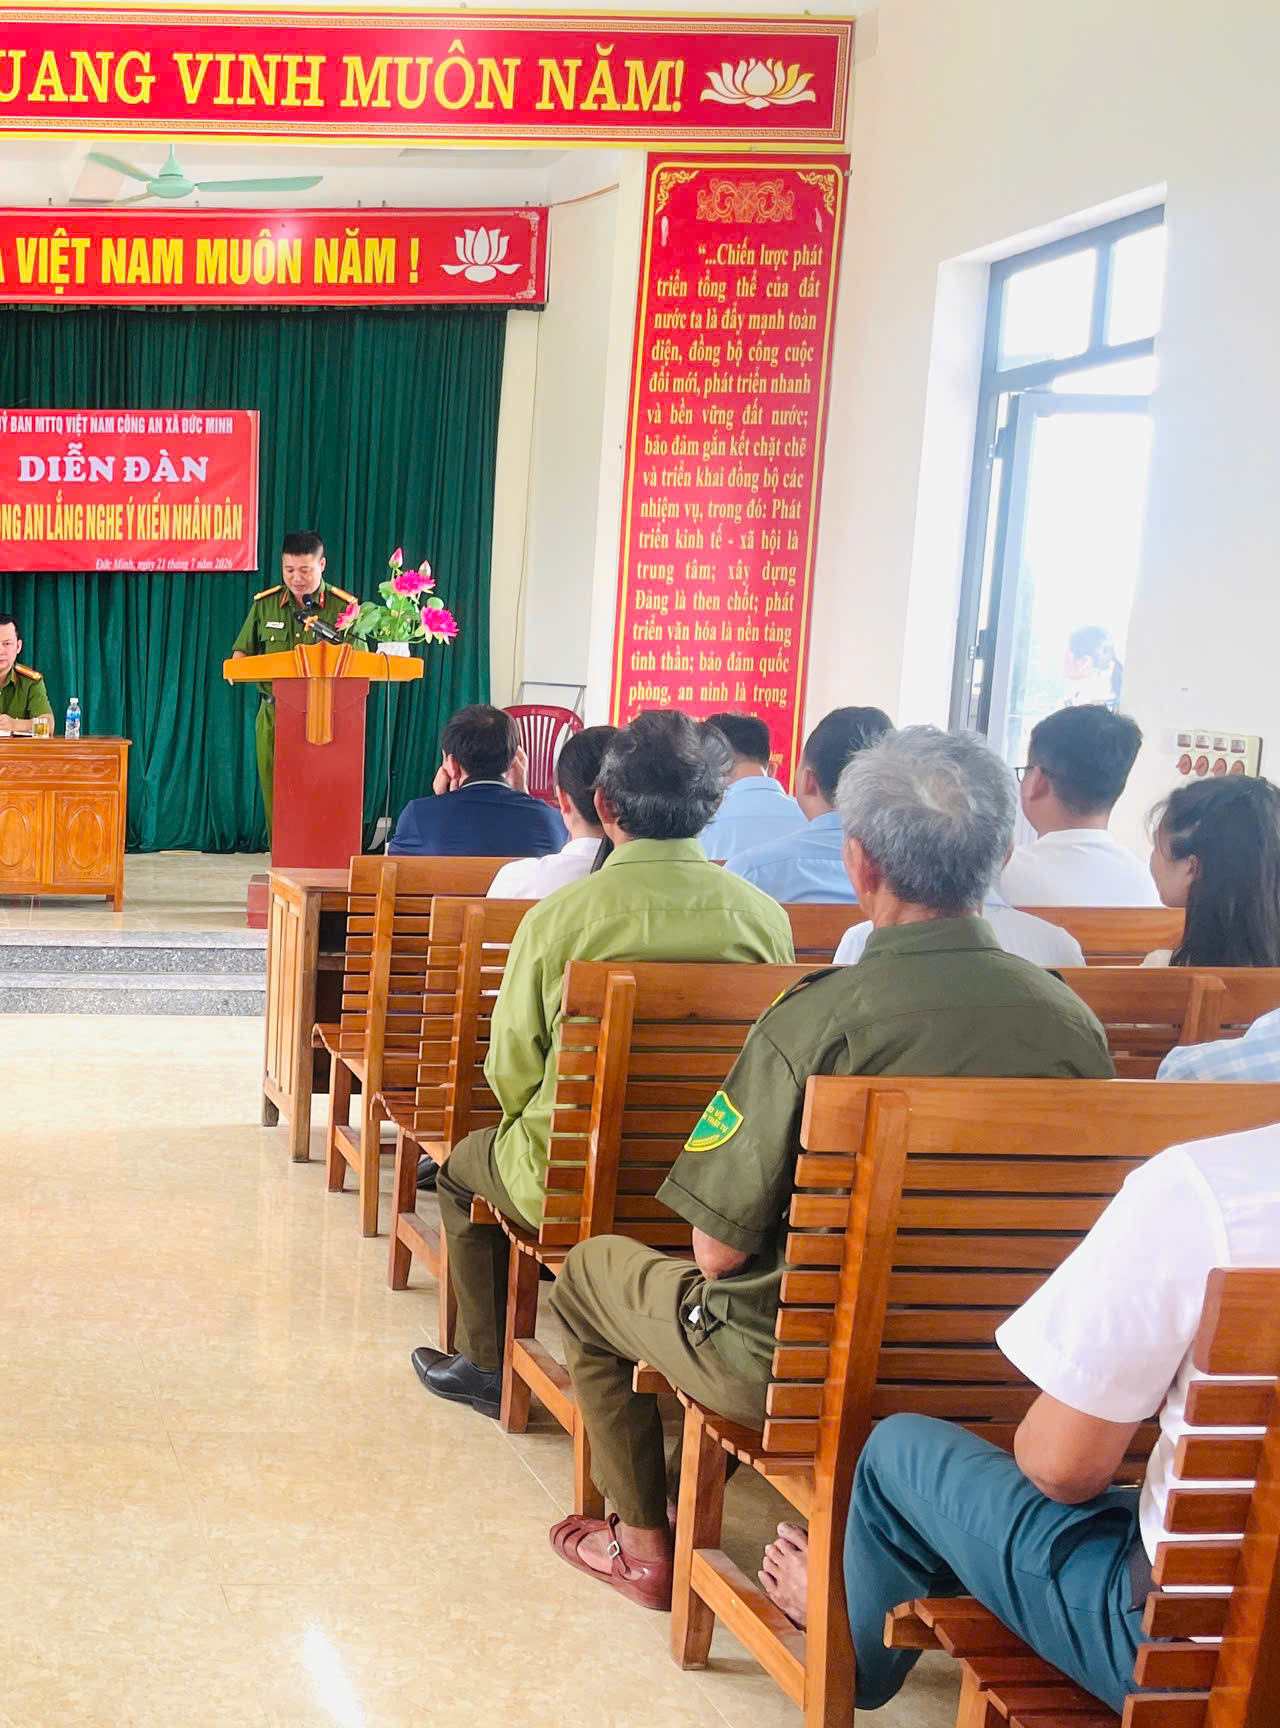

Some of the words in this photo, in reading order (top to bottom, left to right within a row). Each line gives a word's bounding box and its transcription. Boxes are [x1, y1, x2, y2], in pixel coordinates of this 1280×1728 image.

[173, 52, 326, 106] VINH
[340, 39, 521, 110] MUÔN
[535, 42, 684, 112] NĂM!
[15, 227, 90, 294] VIỆT
[102, 238, 183, 283] NAM
[196, 229, 302, 284] MUÔN
[313, 227, 395, 283] NĂM
[408, 238, 419, 283] !
[760, 244, 788, 271] lược
[793, 243, 823, 271] phát
[657, 268, 687, 297] triển
[697, 269, 727, 303] tổng
[736, 269, 757, 297] thể
[766, 276, 788, 297] của
[799, 271, 820, 298] đất
[654, 308, 686, 329] nước
[690, 310, 702, 329] ta
[706, 308, 718, 329] là
[721, 302, 745, 335] đẩy
[748, 309, 784, 335] mạnh
[789, 308, 816, 329] toàn
[651, 339, 682, 366] diện,
[688, 333, 720, 367] đồng
[727, 340, 742, 367] bộ
[748, 340, 778, 367] công
[785, 341, 814, 367] cuộc
[11, 416, 32, 433] BAN
[35, 416, 63, 434] MTTQ
[66, 414, 88, 437] VIỆT
[91, 417, 114, 433] NAM
[118, 415, 145, 434] CÔNG
[148, 417, 163, 434] AN
[166, 415, 179, 434] XÃ
[182, 414, 202, 434] ĐỨC
[206, 417, 233, 434] MINH
[647, 403, 661, 424] và
[670, 397, 692, 424] bền
[702, 405, 734, 430] vững
[742, 398, 763, 425] đất
[772, 404, 808, 428] nước;
[18, 442, 115, 482] DIỄN
[123, 450, 209, 482] ĐÀN
[645, 435, 667, 456] bảo
[672, 435, 699, 455] đảm
[703, 430, 726, 461] gắn
[730, 430, 749, 456] kết
[753, 436, 781, 461] chặt
[784, 437, 806, 456] chẽ
[24, 504, 43, 541] AN
[47, 489, 84, 541] LẮNG
[86, 504, 123, 541] NGHE
[127, 497, 135, 541] Ý
[137, 492, 170, 541] KIẾN
[173, 497, 211, 541] NHÂN
[213, 497, 243, 541] DÂN
[641, 497, 679, 523] nhiệm
[685, 501, 703, 523] vụ,
[708, 500, 742, 523] trong
[747, 499, 766, 519] đó:
[772, 499, 801, 519] Phát
[637, 562, 674, 584] trung
[685, 559, 717, 584] tâm;
[728, 560, 750, 586] xây
[762, 561, 796, 586] dựng
[633, 615, 662, 640] triển
[668, 623, 689, 640] văn
[694, 621, 717, 640] hóa
[721, 622, 732, 640] là
[737, 616, 759, 641] nền
[764, 623, 792, 648] tảng
[629, 681, 671, 706] phòng,
[678, 688, 693, 700] an
[700, 682, 728, 700] ninh
[735, 682, 746, 701] là
[753, 685, 787, 707] trọng
